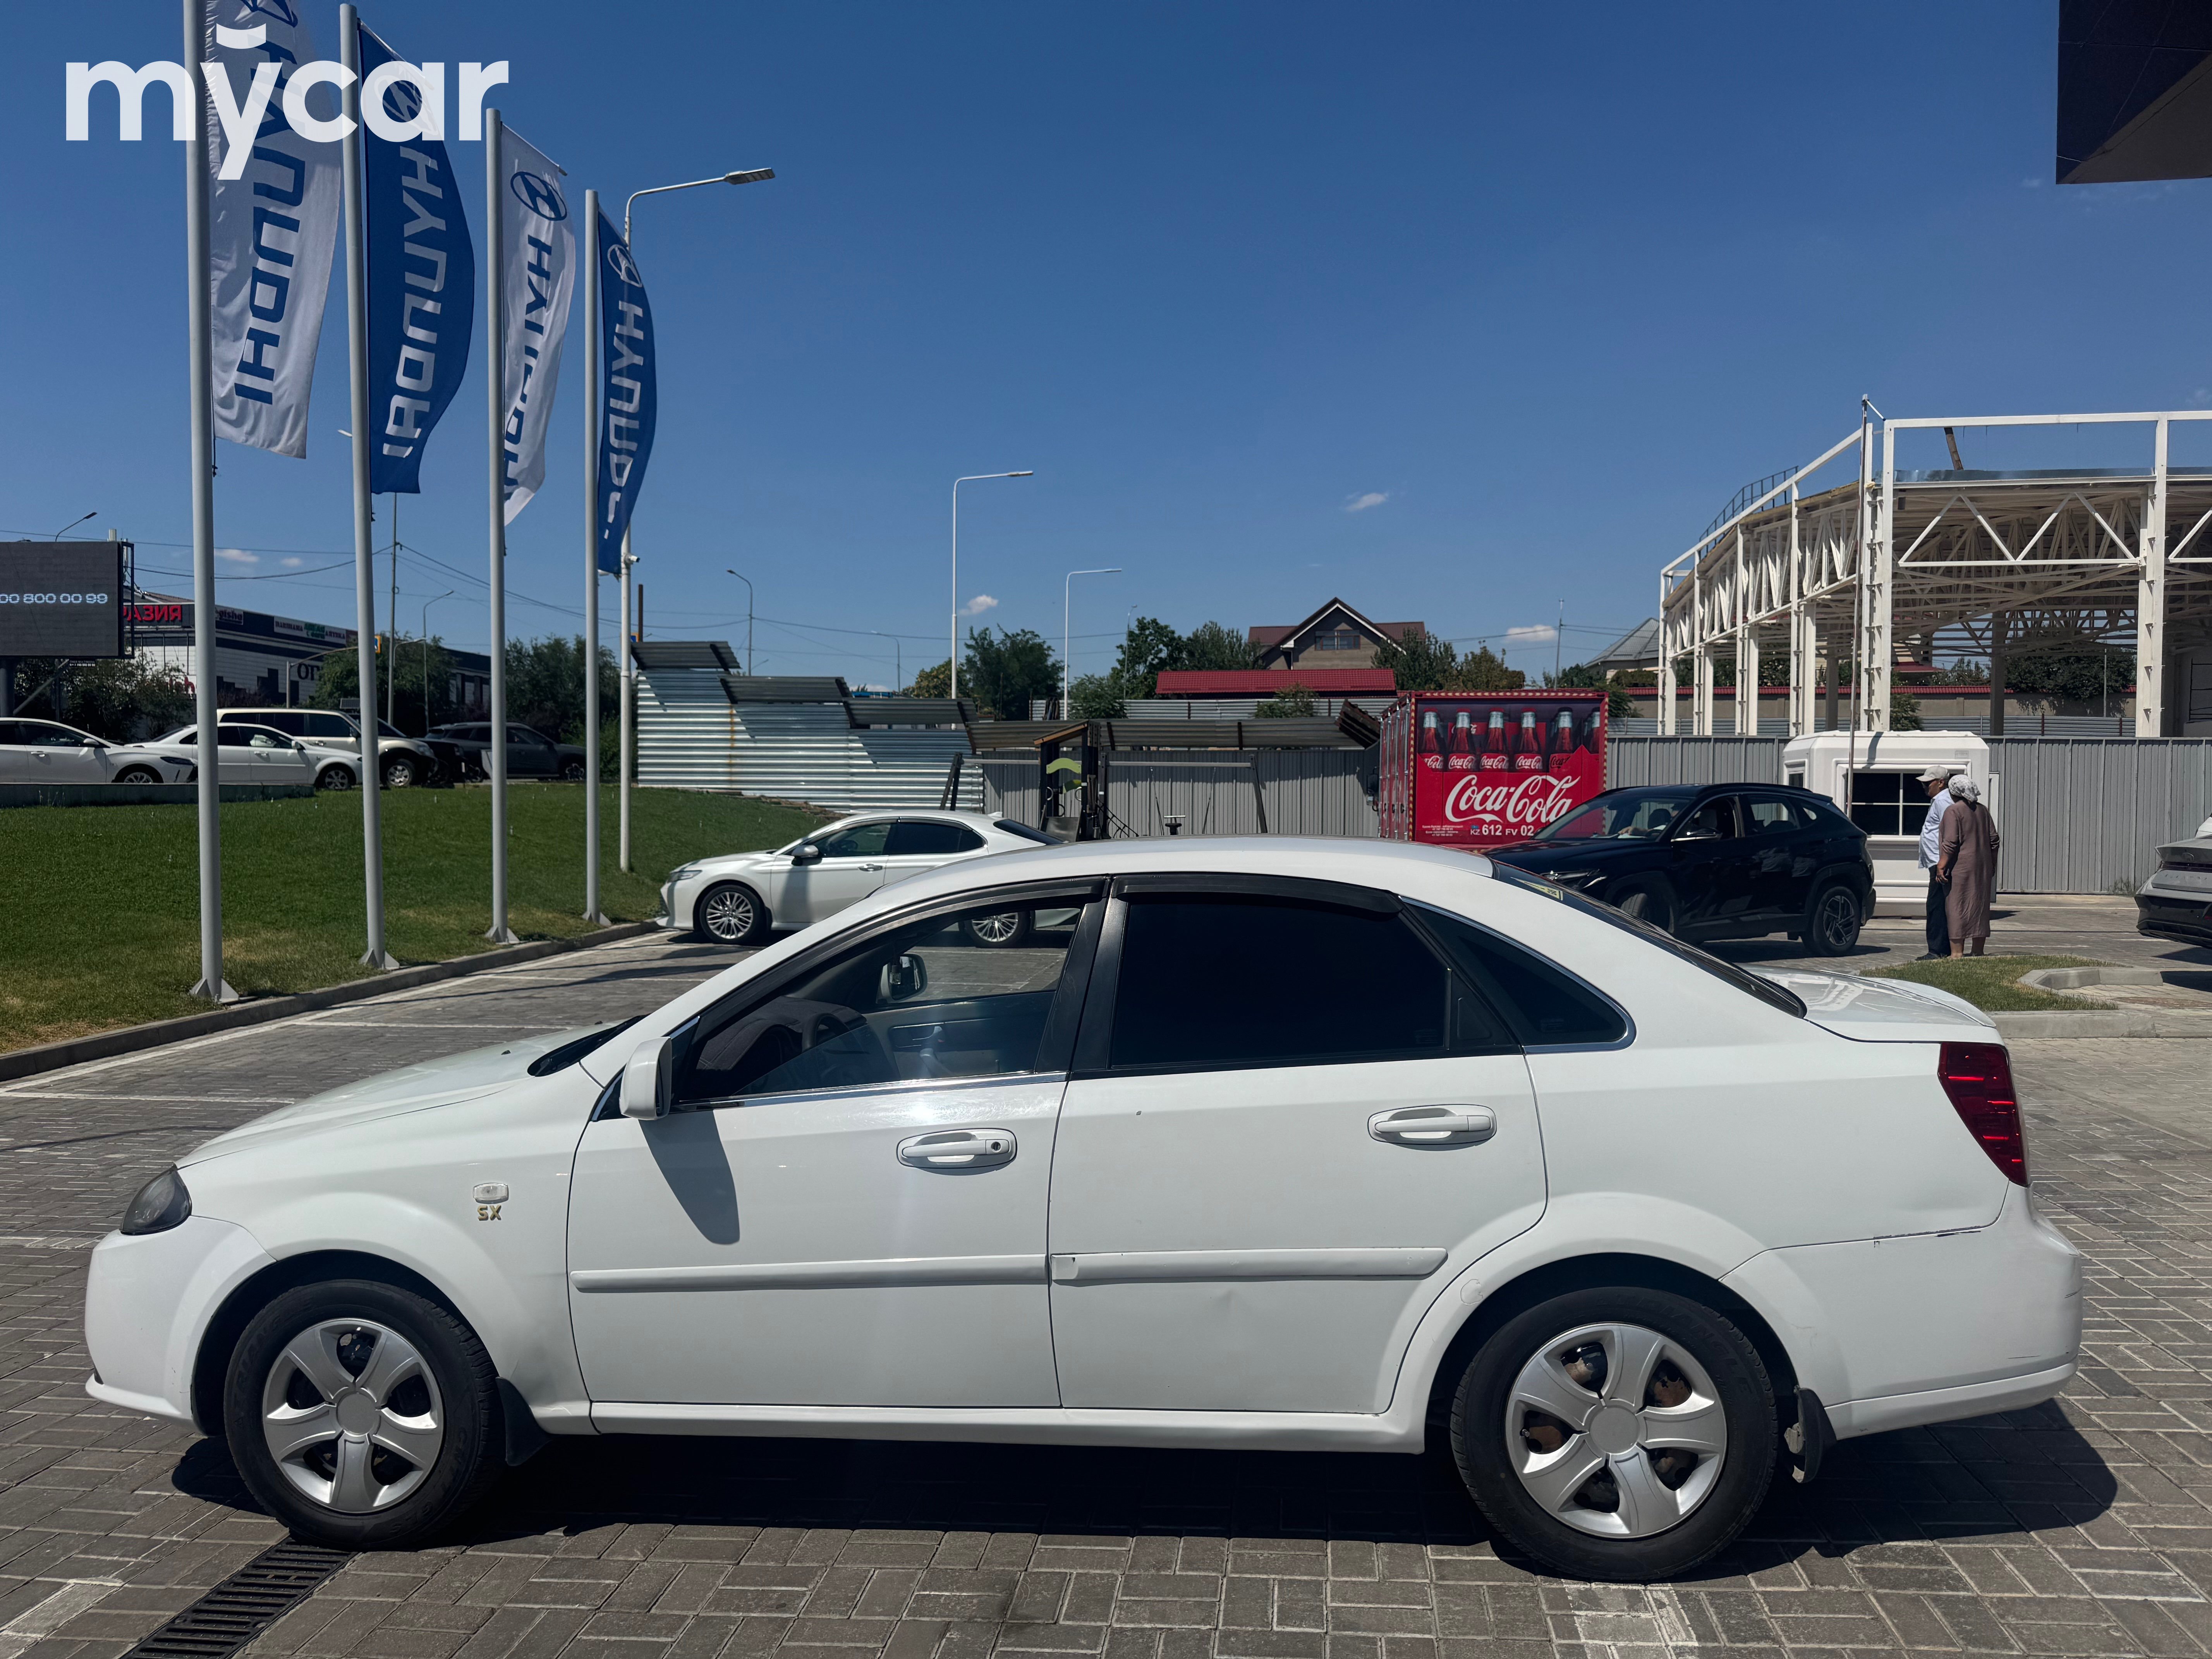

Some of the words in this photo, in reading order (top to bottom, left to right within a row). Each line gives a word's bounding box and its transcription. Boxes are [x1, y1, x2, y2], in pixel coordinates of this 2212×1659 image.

[23, 593, 56, 603] 800
[60, 593, 82, 603] 00
[86, 593, 108, 604] 99
[1445, 775, 1581, 823] Coca-Cola
[1482, 824, 1502, 835] 612
[1520, 825, 1534, 836] 02
[477, 1205, 502, 1221] SX
